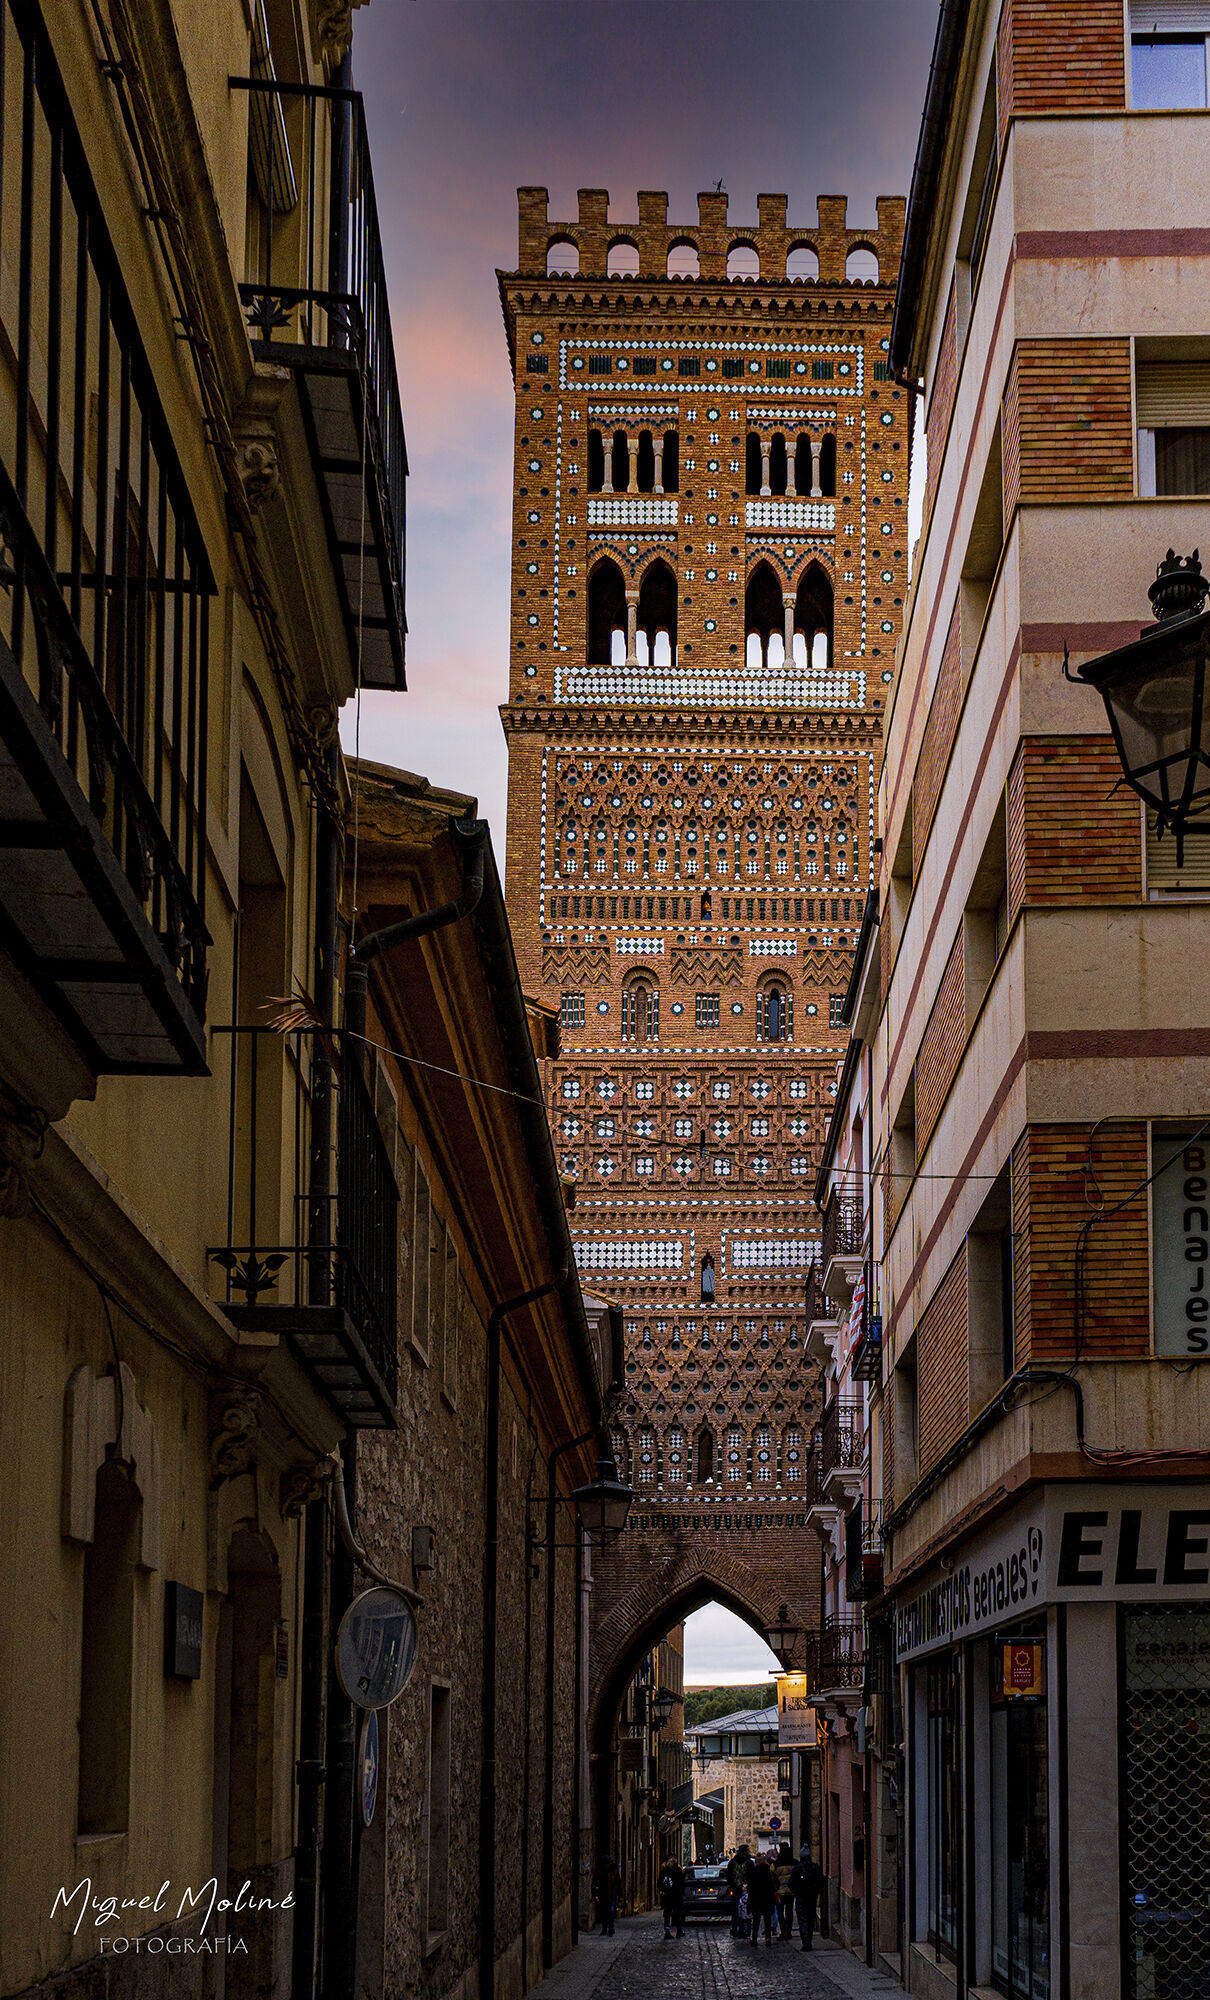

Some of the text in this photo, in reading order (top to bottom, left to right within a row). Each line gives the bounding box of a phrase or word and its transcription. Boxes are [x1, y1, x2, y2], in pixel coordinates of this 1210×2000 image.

[1183, 1146, 1209, 1353] Benajes
[974, 1548, 1028, 1621] Benajes
[1057, 1510, 1210, 1586] ELE
